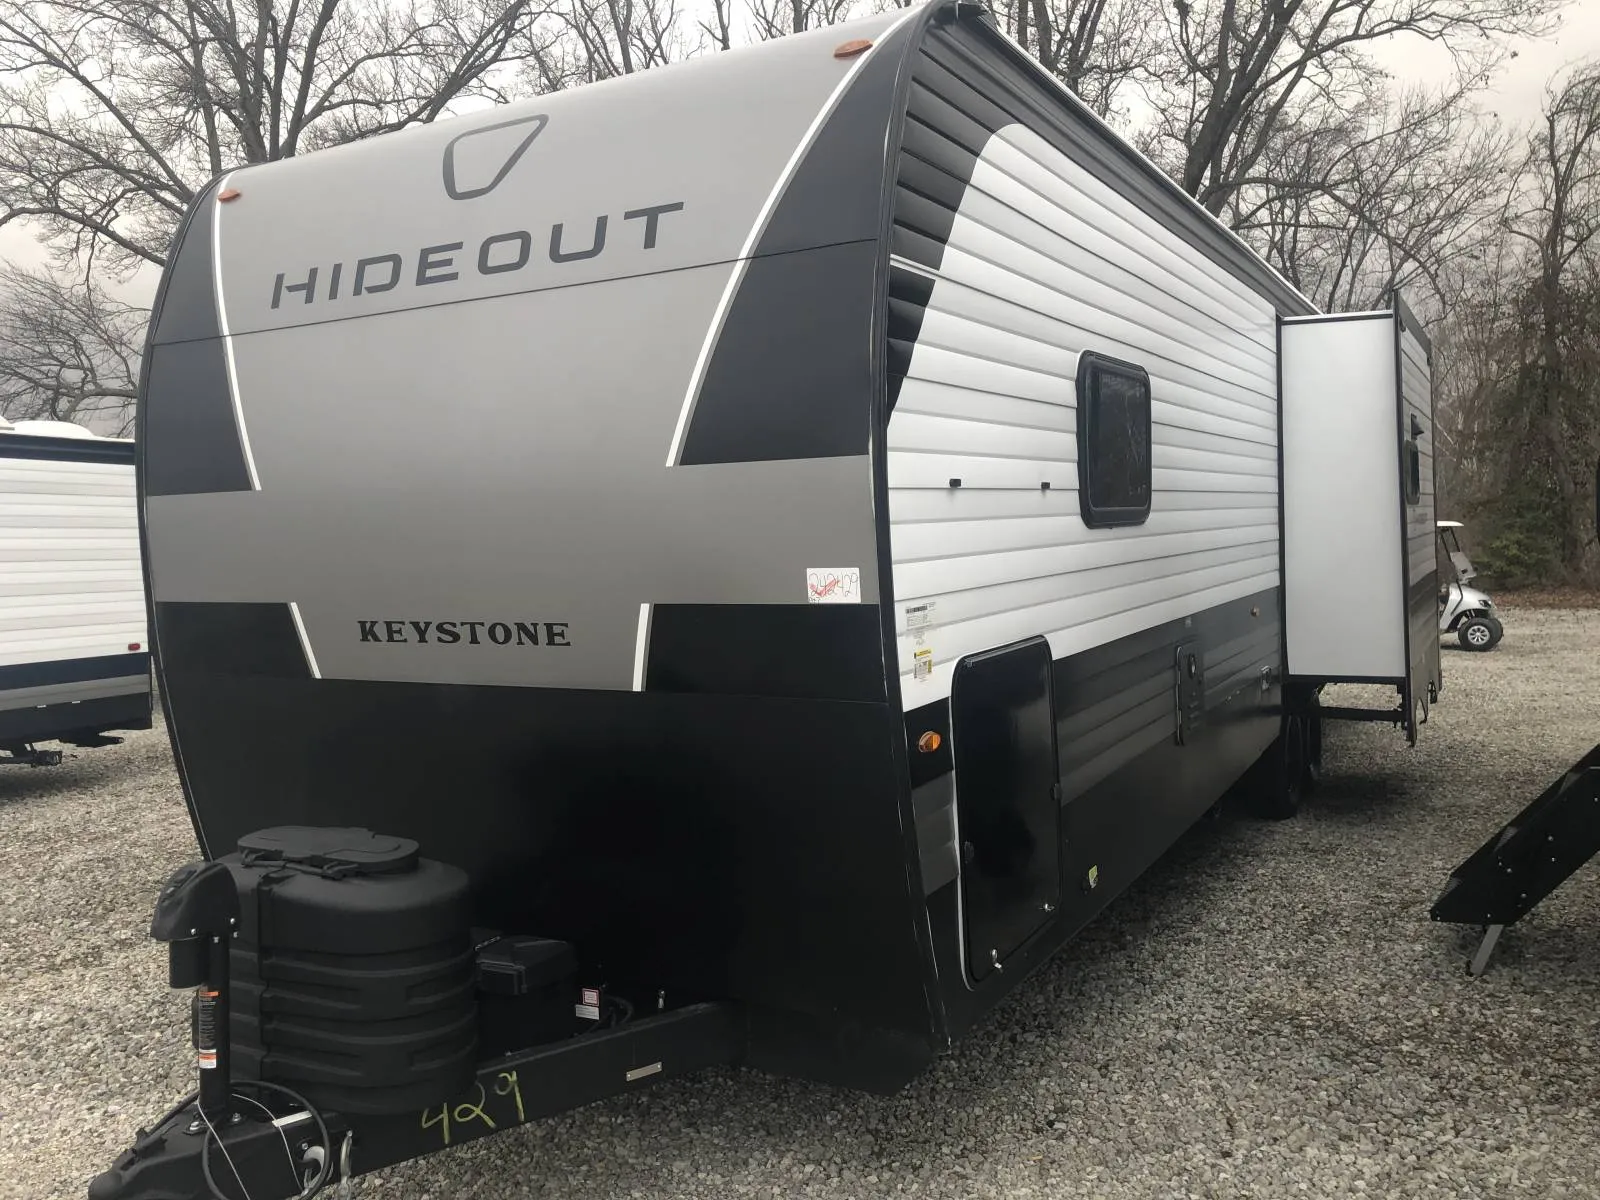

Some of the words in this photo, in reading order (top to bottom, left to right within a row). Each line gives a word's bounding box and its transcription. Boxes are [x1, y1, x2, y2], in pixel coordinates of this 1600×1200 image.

[270, 201, 685, 310] HIDEOUT
[357, 620, 571, 647] KEYSTONE
[421, 1070, 525, 1145] 429
